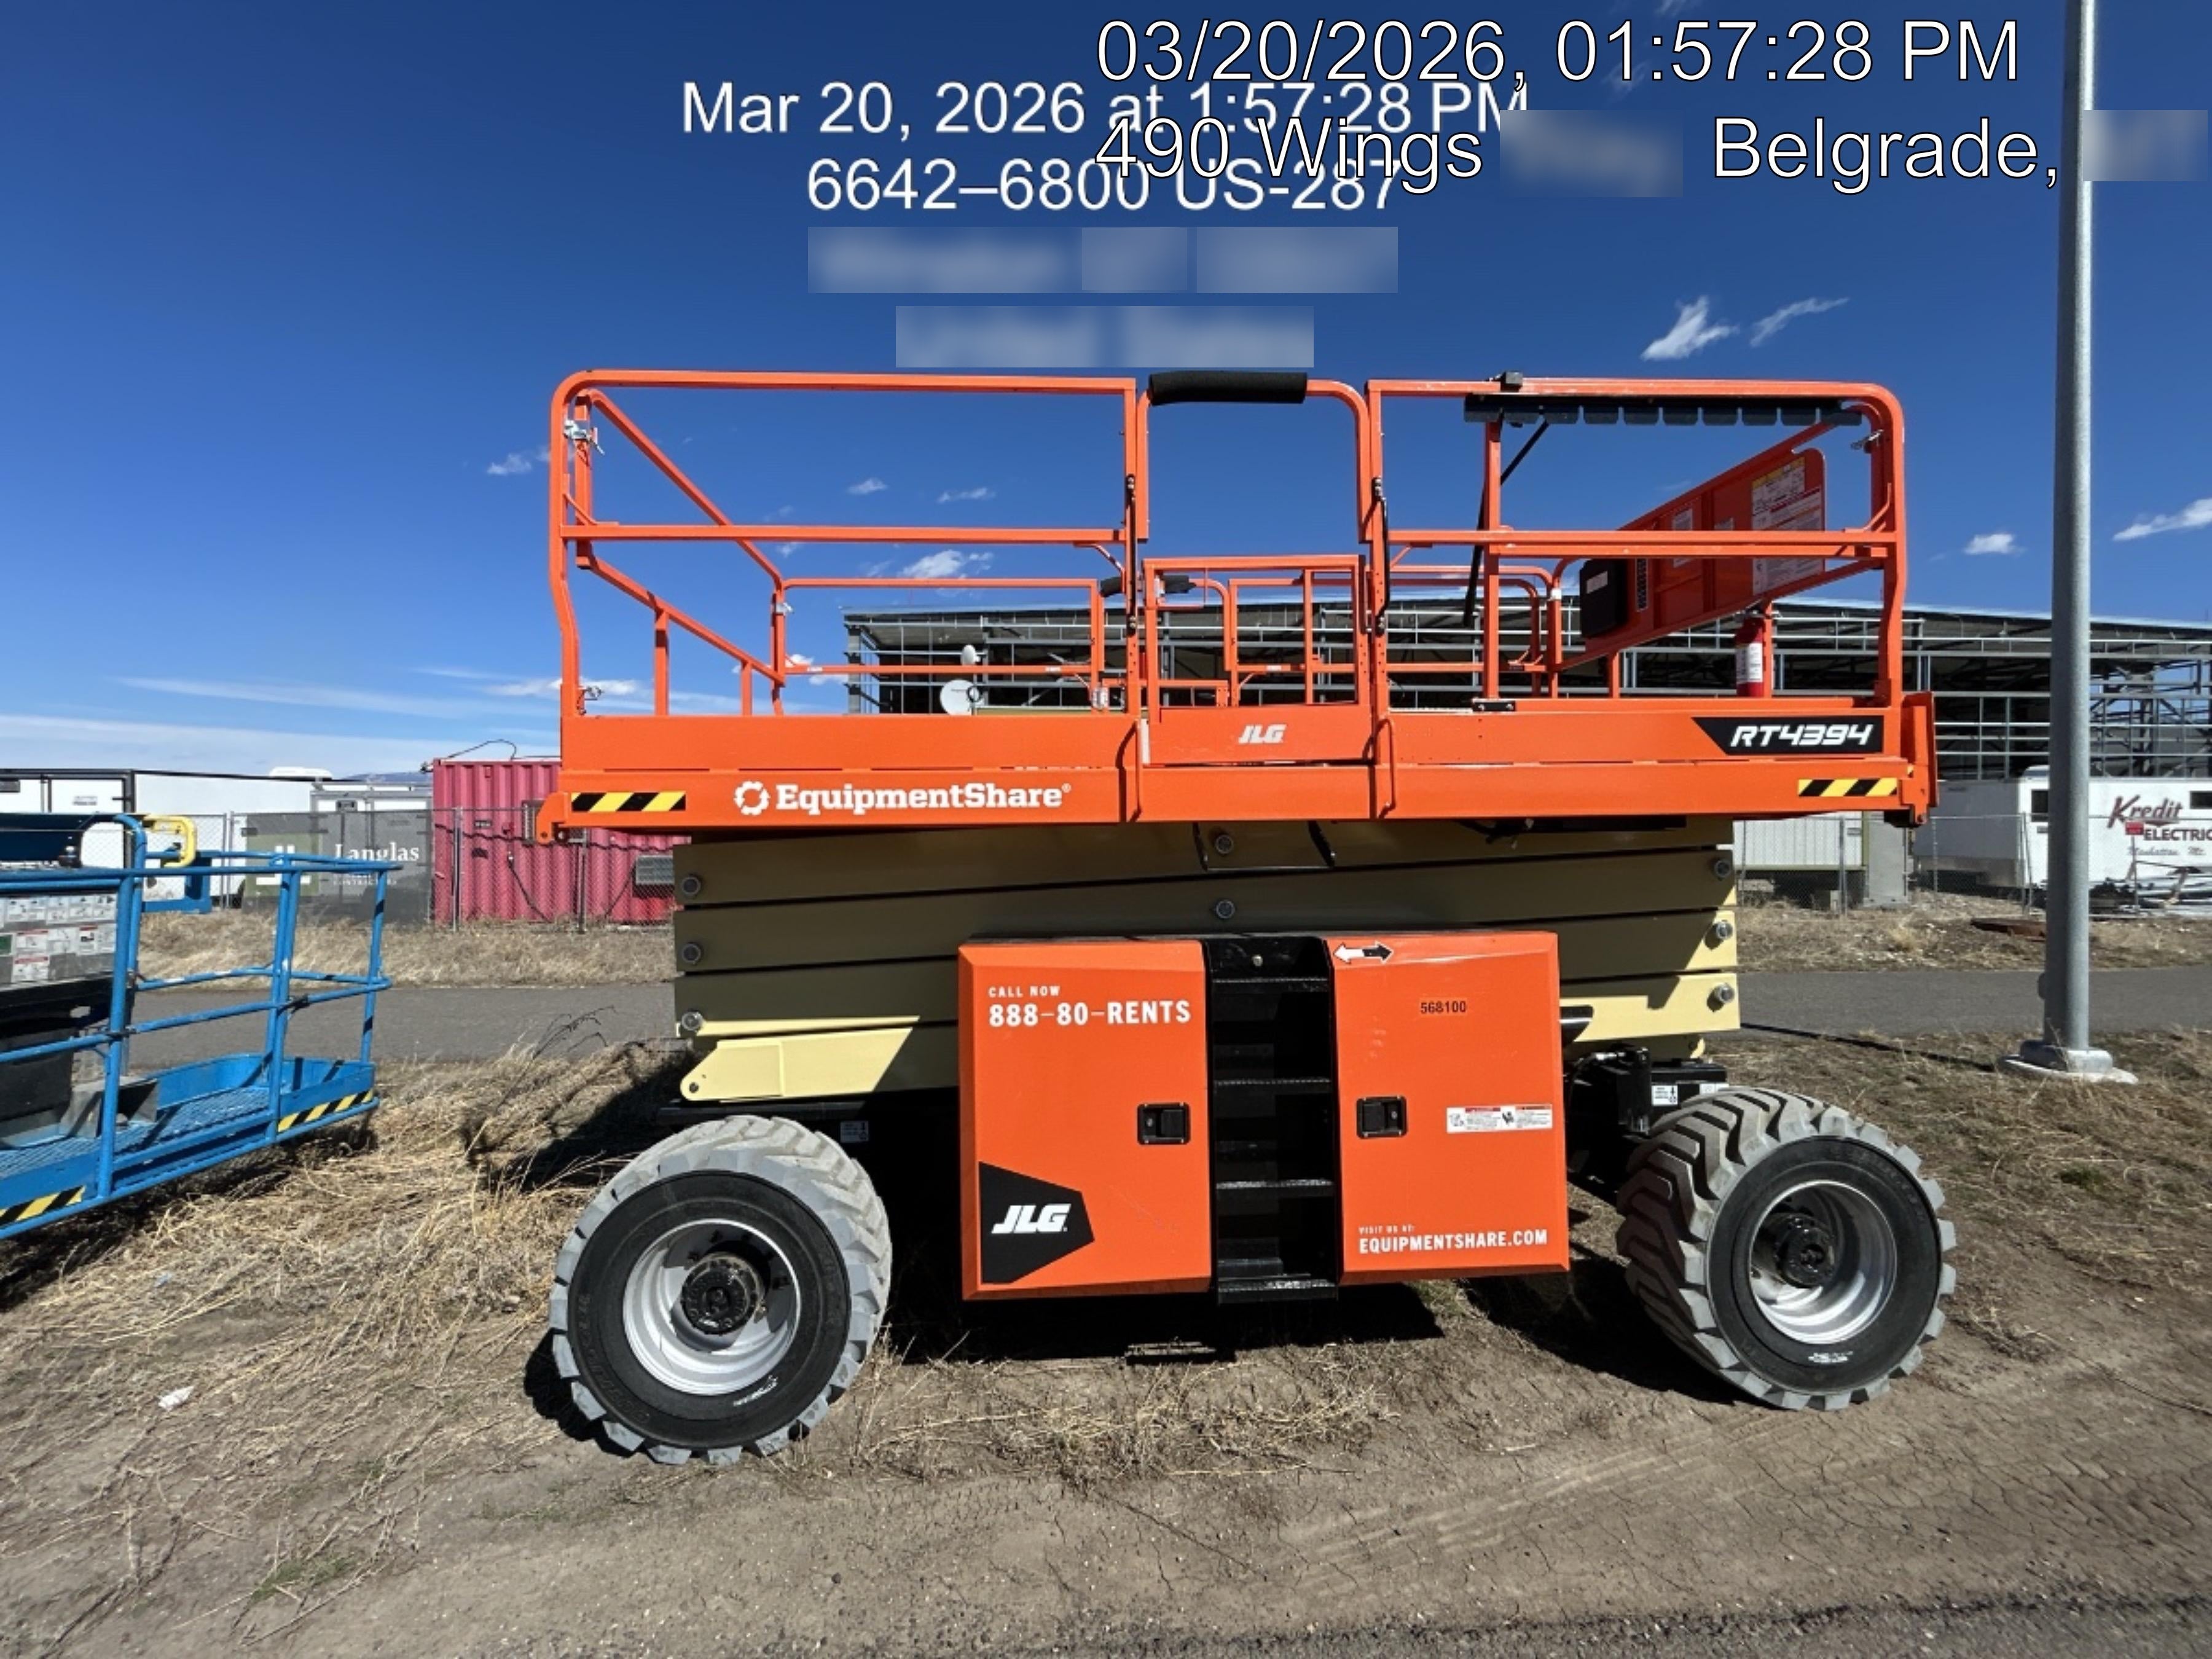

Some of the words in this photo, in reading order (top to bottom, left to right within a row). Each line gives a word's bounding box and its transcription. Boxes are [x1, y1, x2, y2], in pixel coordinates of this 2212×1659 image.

[1239, 724, 1287, 744] JLG
[1730, 724, 1873, 747] RT4394
[2107, 794, 2183, 828] Kredit
[989, 987, 1024, 998] CALL
[1030, 986, 1061, 997] NOW
[989, 1000, 1191, 1027] 888-80-RENTS
[1420, 1000, 1467, 1014] 568100
[991, 1204, 1072, 1234] JLG
[1359, 1229, 1548, 1253] EQUIPMENTSHARE.COM
